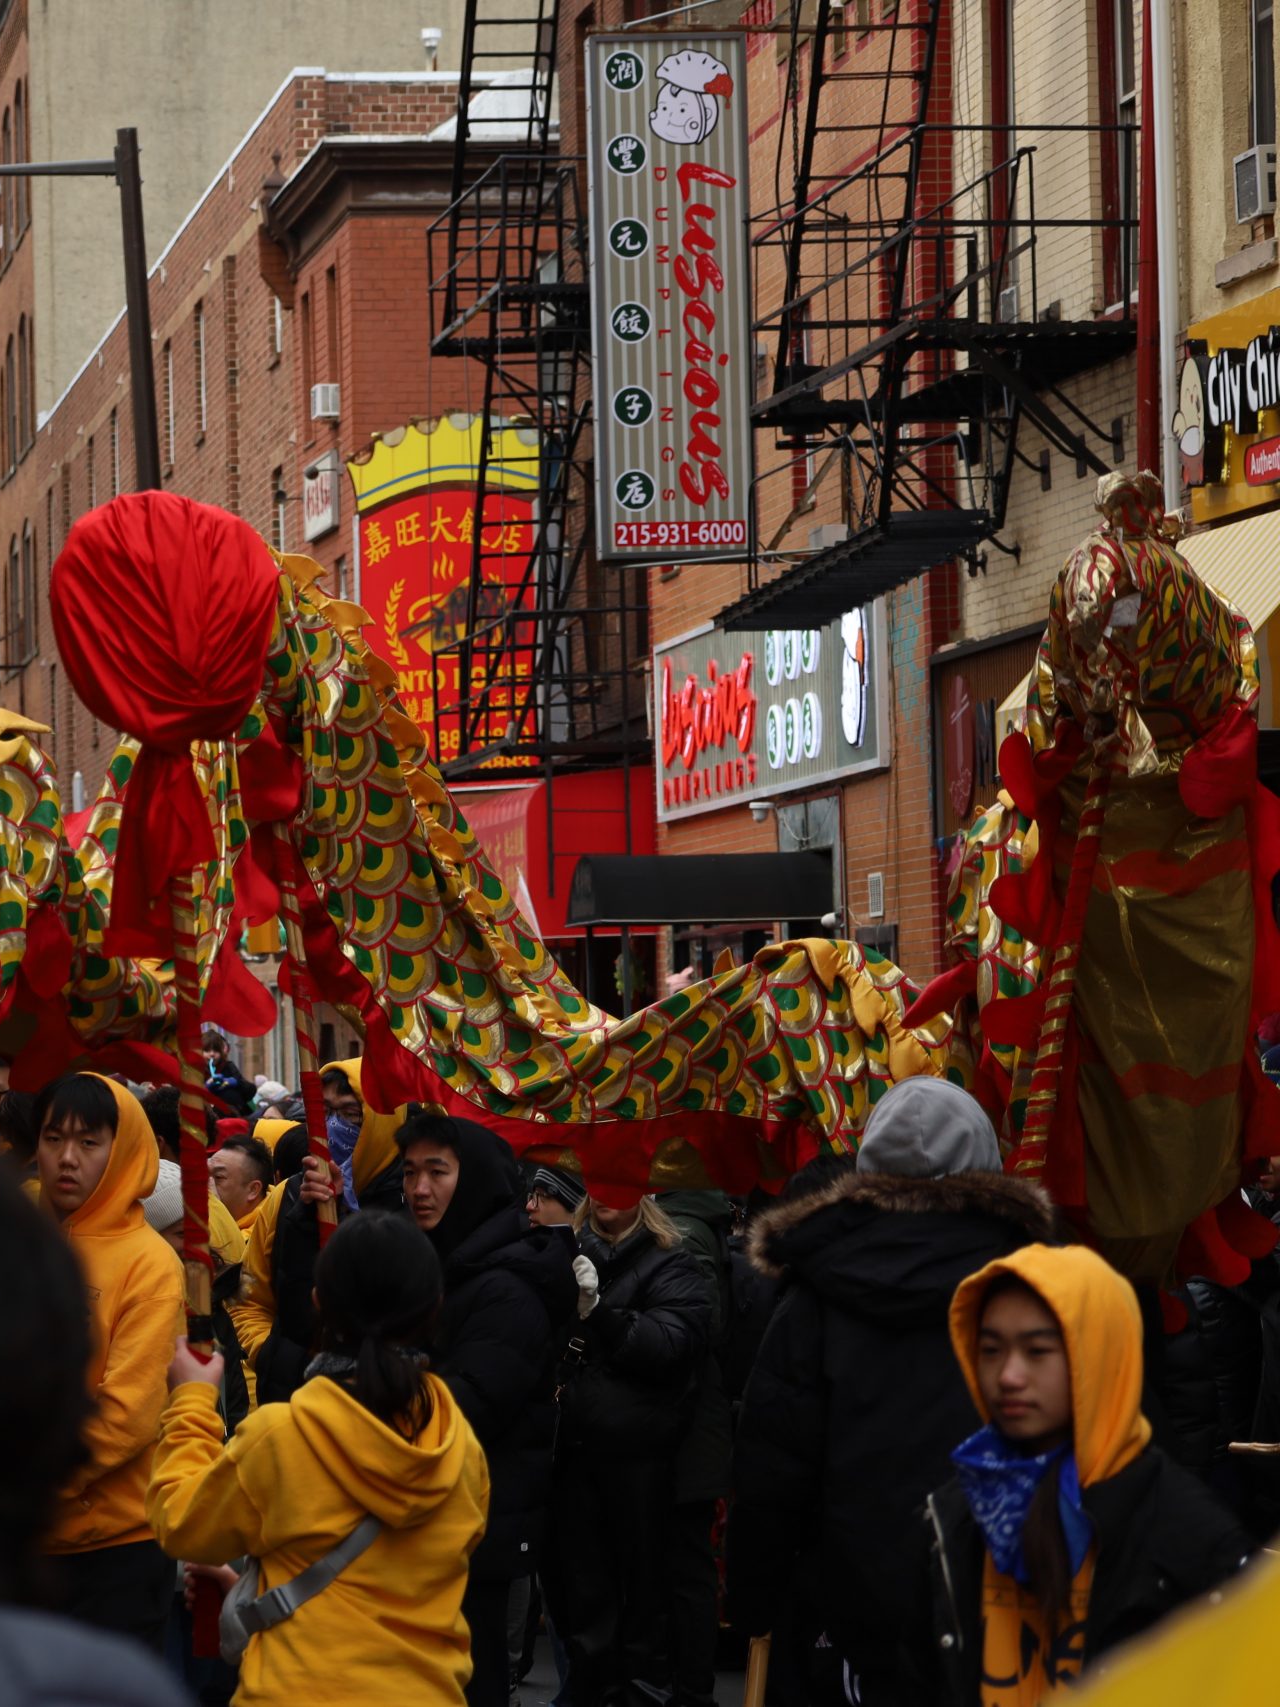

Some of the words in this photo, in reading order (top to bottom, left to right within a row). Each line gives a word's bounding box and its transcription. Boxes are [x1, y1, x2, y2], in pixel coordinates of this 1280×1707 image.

[653, 167, 676, 502] DUMPLINGS
[674, 162, 736, 510] Luscious
[617, 523, 744, 545] 215-931-6000
[663, 753, 757, 808] DUMPLINGS
